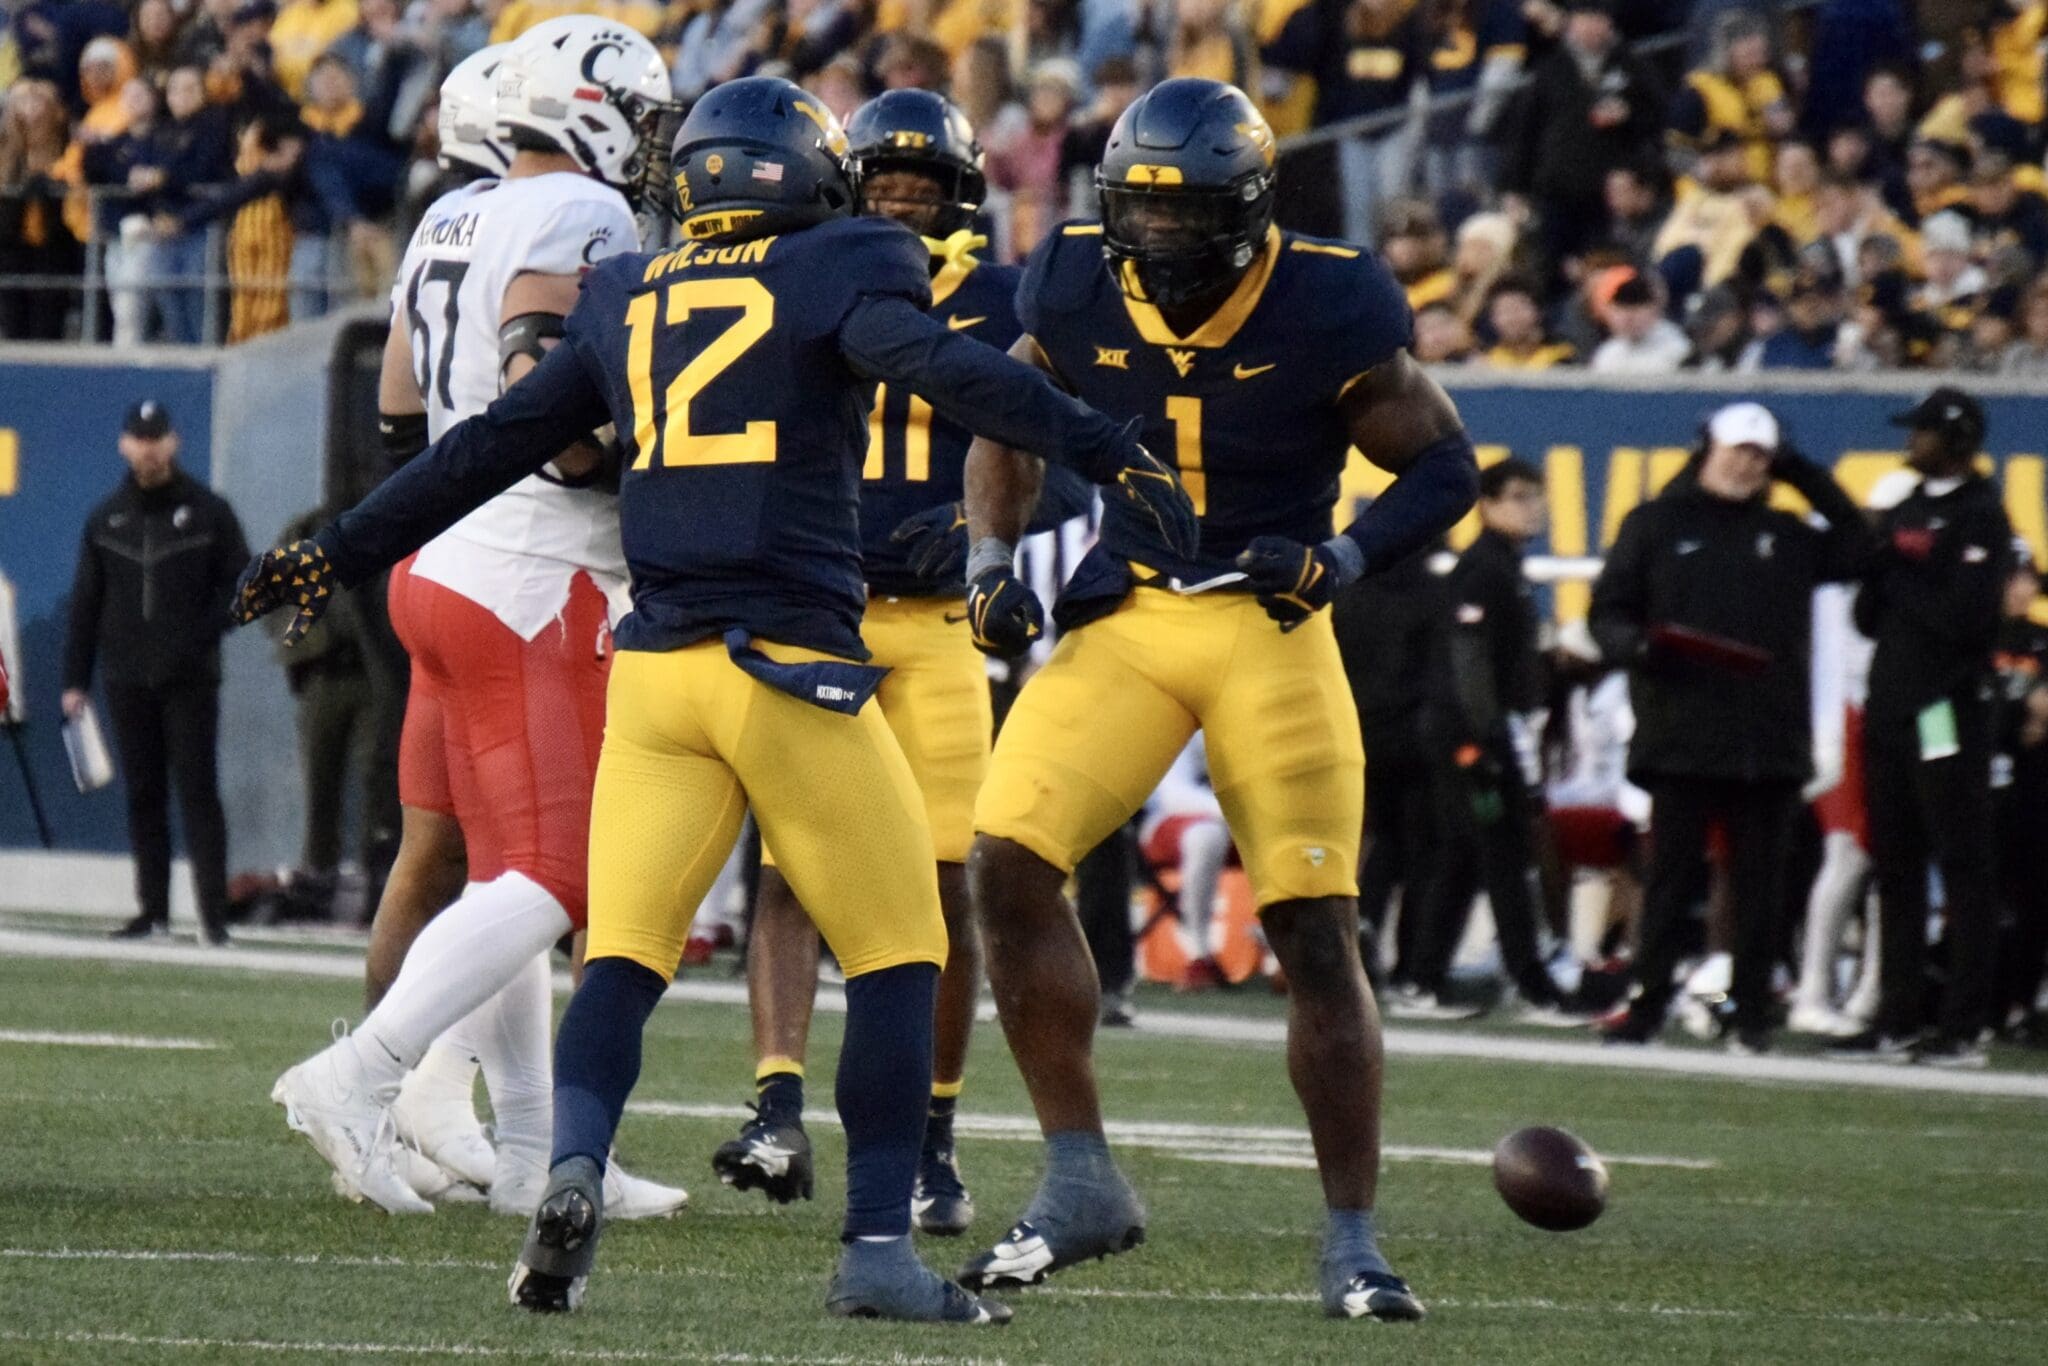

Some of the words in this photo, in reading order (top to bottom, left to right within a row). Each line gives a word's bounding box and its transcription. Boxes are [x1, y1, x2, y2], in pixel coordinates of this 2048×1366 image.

[642, 235, 779, 283] WILSON
[406, 258, 471, 412] 67
[624, 276, 777, 470] 12
[1094, 347, 1130, 369] XII
[862, 381, 934, 482] 11
[1166, 395, 1206, 517] 1
